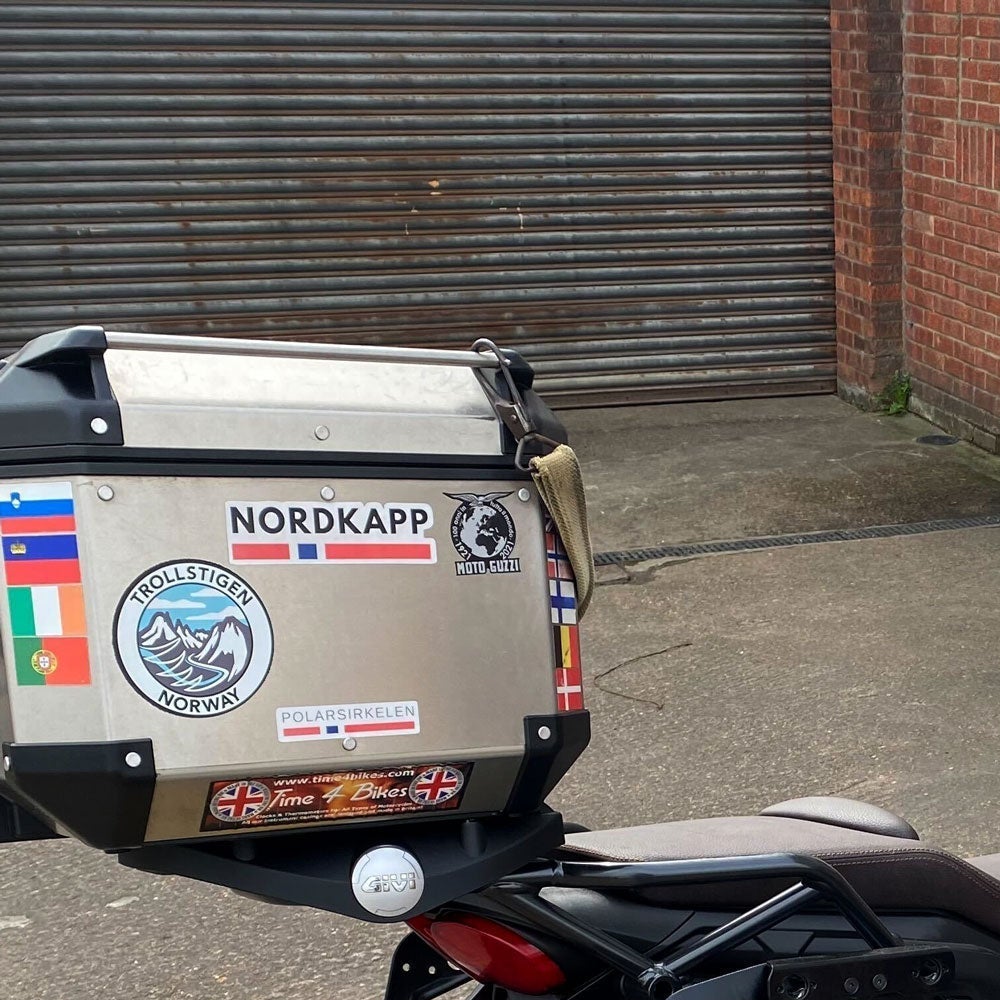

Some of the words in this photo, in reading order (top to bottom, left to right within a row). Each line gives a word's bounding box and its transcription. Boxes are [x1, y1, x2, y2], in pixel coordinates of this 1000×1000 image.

[229, 506, 428, 534] NORDKAPP
[455, 542, 472, 560] 1921
[500, 541, 514, 559] 2021
[456, 561, 485, 575] MOTO
[489, 559, 519, 573] GUZZI
[130, 565, 254, 606] TROLLSTIGEN
[158, 687, 241, 713] NORWAY
[281, 705, 416, 723] POLARSIRKELEN
[273, 769, 415, 787] www.time4bikes.com
[266, 788, 315, 811] Time
[321, 784, 347, 804] 4
[350, 782, 408, 801] Bikes
